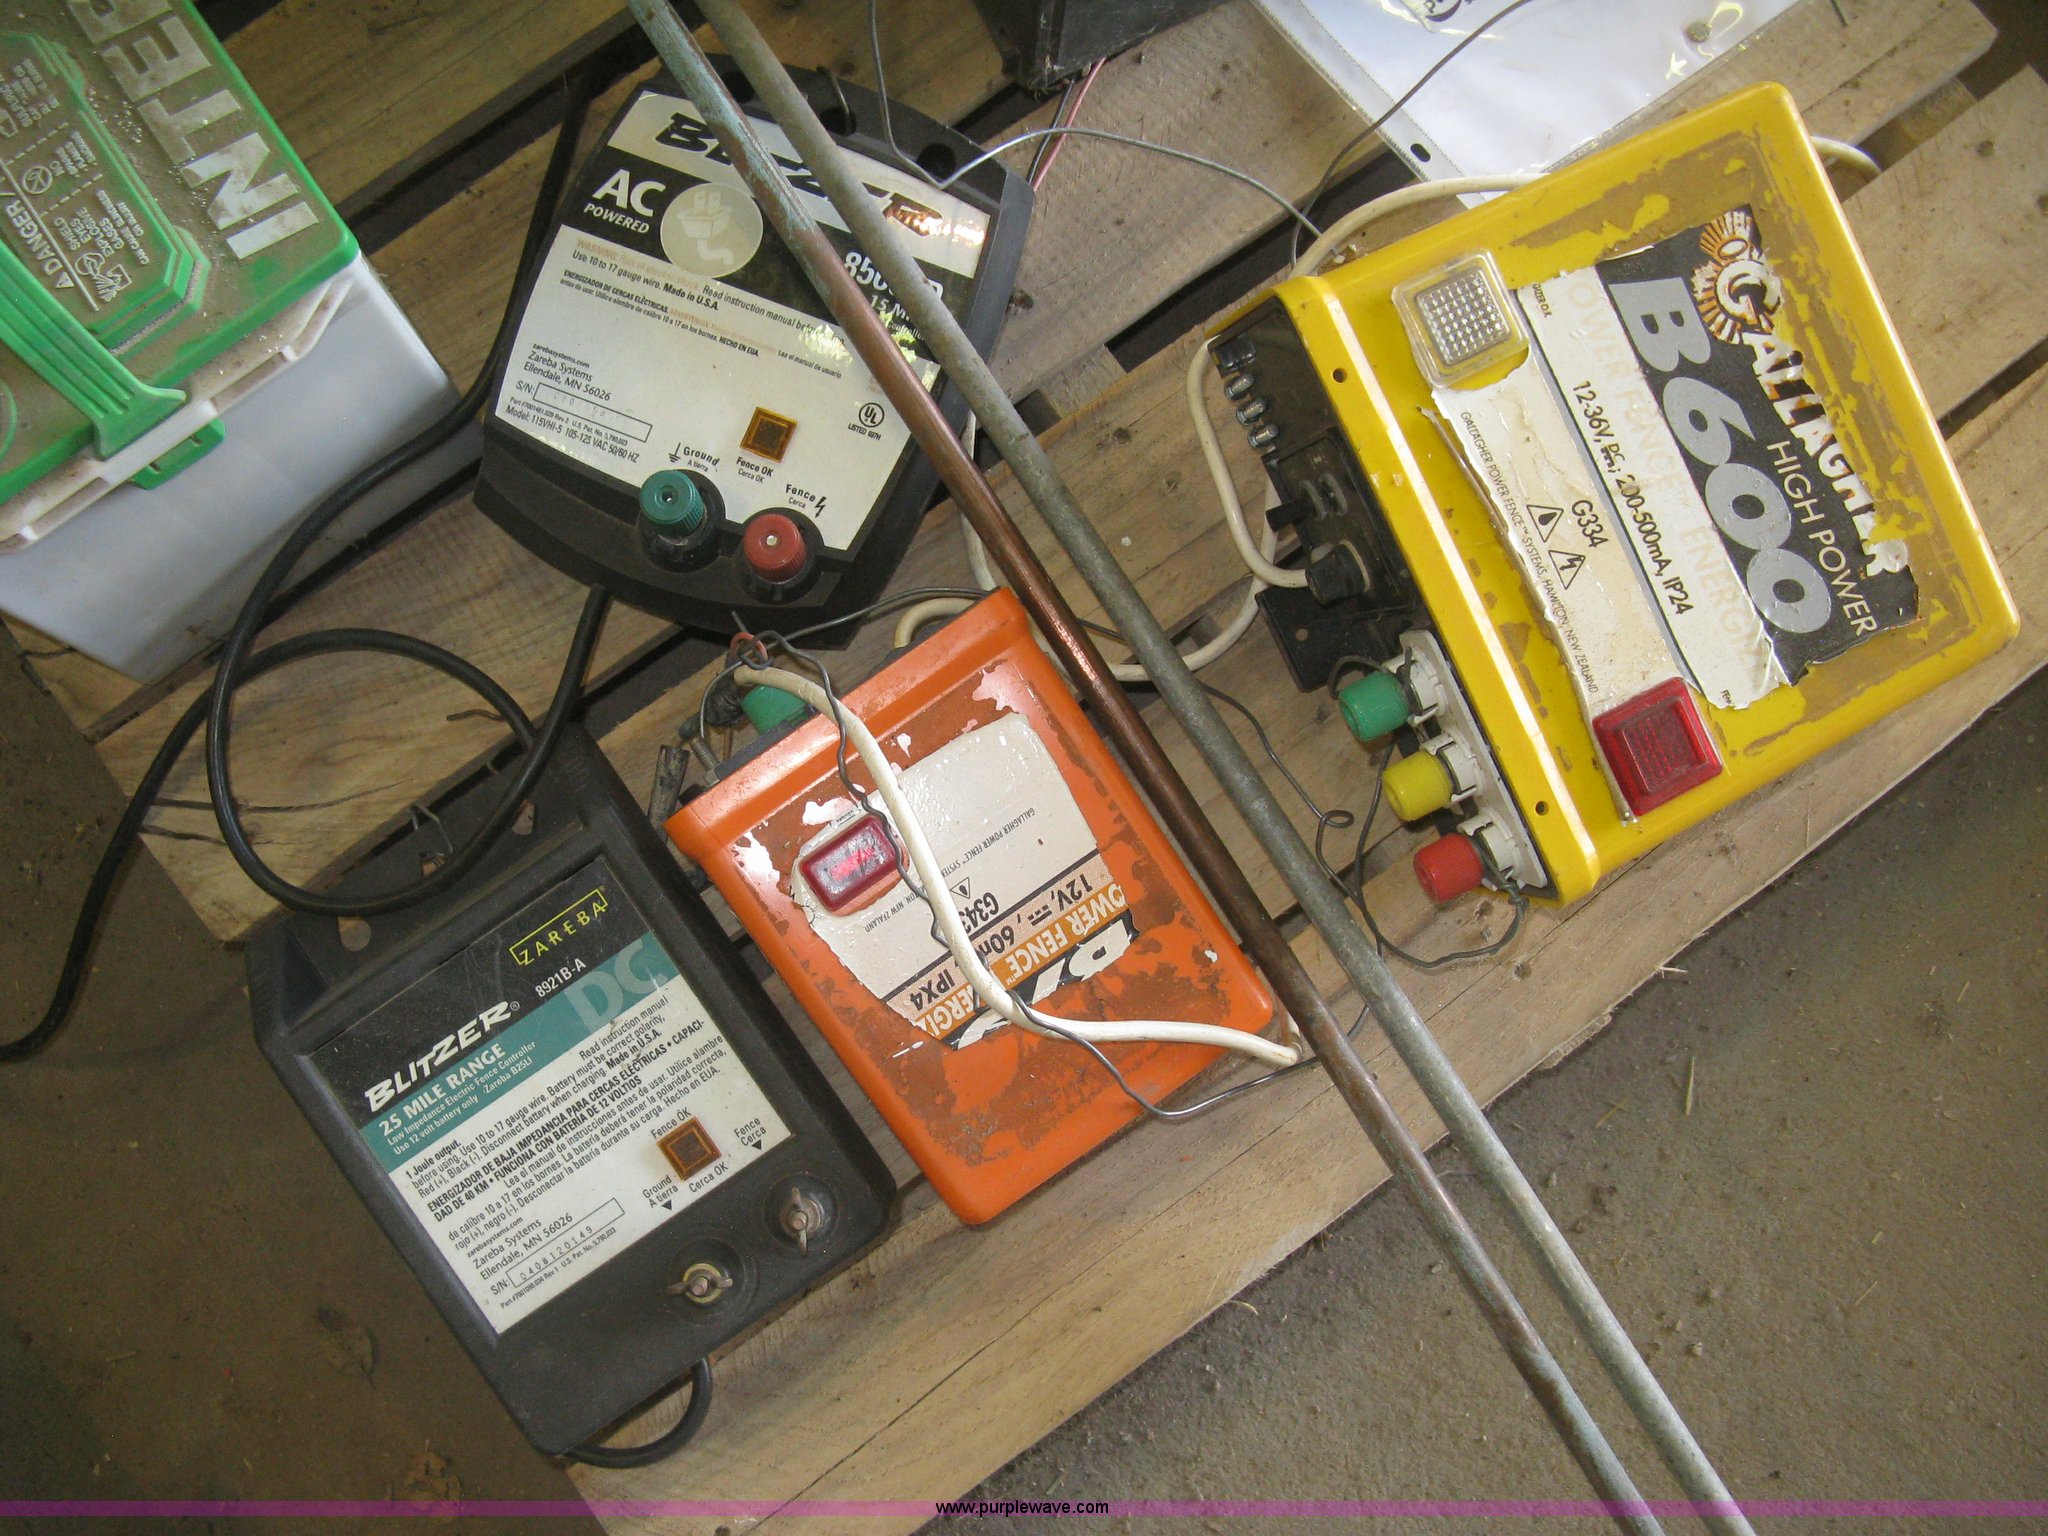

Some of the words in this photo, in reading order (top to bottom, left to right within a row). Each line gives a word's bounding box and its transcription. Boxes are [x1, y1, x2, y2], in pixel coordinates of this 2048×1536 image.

[591, 162, 666, 220] AC
[3, 198, 63, 276] DANGER
[53, 215, 81, 251] SHIELD
[69, 216, 92, 243] EYES
[75, 205, 115, 257] EXPLOSIVE
[97, 216, 126, 250] GASES
[583, 200, 650, 236] POWERED
[571, 249, 589, 263] Use
[588, 255, 599, 266] 10
[598, 259, 607, 269] to
[607, 262, 618, 273] 17
[616, 267, 641, 284] gauge
[641, 275, 663, 290] wire.
[662, 282, 686, 299] Made
[686, 291, 696, 302] in
[695, 294, 721, 311] U.S.A.
[701, 284, 724, 300] Read
[723, 292, 766, 316] instruction
[765, 308, 795, 327] manual
[515, 379, 536, 395] S/N:
[522, 360, 564, 384] Ellendale,
[563, 376, 582, 390] MN
[582, 383, 612, 401] 56026
[527, 350, 558, 369] Zareba
[557, 361, 593, 384] Systems
[504, 404, 530, 421] Model:
[591, 437, 608, 451] VAC
[627, 451, 640, 463] HZ
[682, 445, 720, 467] Ground
[735, 456, 760, 472] Fence
[760, 465, 774, 477] OK
[737, 467, 756, 480] Cerca
[754, 474, 766, 484] OK
[1607, 276, 1832, 635] B600
[783, 482, 817, 503] Fence
[787, 496, 807, 509] Cerca
[1569, 496, 1609, 549] G334
[1765, 436, 1825, 526] HIGH
[1806, 524, 1879, 638] POWER
[1485, 463, 1509, 498] POWER
[1563, 627, 1583, 653] NEW
[1661, 575, 1694, 616] IP24
[980, 828, 1004, 849] POWER
[1001, 806, 1036, 834] GALLAGHER
[889, 900, 905, 914] NEW
[517, 899, 606, 966] ZAREBA
[533, 955, 587, 998] 8921B-A
[561, 937, 670, 1034] DC
[906, 967, 957, 1011] IPX4
[578, 1041, 601, 1061] Read
[598, 1013, 641, 1047] instruction
[638, 994, 669, 1020] manual
[377, 1112, 403, 1136] 25
[401, 1082, 447, 1119] MILE
[444, 1041, 506, 1090] RANGE
[386, 1129, 405, 1146] Low
[403, 1101, 448, 1136] Impedance
[444, 1081, 476, 1106] Electric
[473, 1065, 499, 1086] Fence
[497, 1039, 537, 1070] Controller
[410, 1166, 438, 1189] before
[436, 1151, 462, 1174] using.
[458, 1140, 476, 1156] Use
[474, 1133, 487, 1145] 10
[484, 1127, 496, 1139] to
[493, 1120, 505, 1132] 17
[504, 1105, 530, 1128] gauge
[526, 1090, 549, 1110] wire.
[546, 1071, 579, 1099] Battery
[574, 1058, 596, 1077] must
[593, 1050, 606, 1064] be
[604, 1031, 635, 1057] correct
[632, 1011, 667, 1039] polarity,
[392, 1139, 410, 1155] Use
[408, 1132, 421, 1144] 12
[417, 1122, 435, 1138] volt
[433, 1104, 462, 1128] battery
[459, 1092, 480, 1111] only
[417, 1182, 435, 1198] Red
[445, 1157, 470, 1178] Black
[479, 1121, 524, 1156] Disconnect
[521, 1102, 552, 1129] battery
[548, 1087, 572, 1108] when
[569, 1063, 609, 1095] charging.
[604, 1048, 630, 1070] Made
[627, 1042, 639, 1054] in
[635, 1026, 663, 1049] U.S.A.
[426, 1169, 484, 1212] ENERGIZADOR
[480, 1161, 495, 1175] DE
[492, 1145, 518, 1167] BAJA
[514, 1111, 568, 1152] IMPEDANCIA
[565, 1096, 590, 1118] PARA
[587, 1074, 621, 1102] CERCAS
[670, 1016, 706, 1045] CAPACI-
[650, 1116, 678, 1139] Fence
[675, 1106, 692, 1122] OK
[733, 1115, 761, 1138] Fence
[410, 1155, 435, 1175] Joule
[432, 1137, 463, 1162] output.
[739, 1124, 767, 1147] Cerca
[641, 1173, 673, 1199] Ground
[647, 1197, 658, 1208] A
[654, 1182, 679, 1203] tierra
[688, 1170, 715, 1193] Cerca
[712, 1161, 728, 1176] OK
[471, 1242, 505, 1269] Zareba
[503, 1217, 544, 1249] Systems
[479, 1245, 525, 1281] Ellendale,
[522, 1233, 543, 1251] MN
[541, 1211, 574, 1238] 56026
[489, 1276, 511, 1296] S/N:
